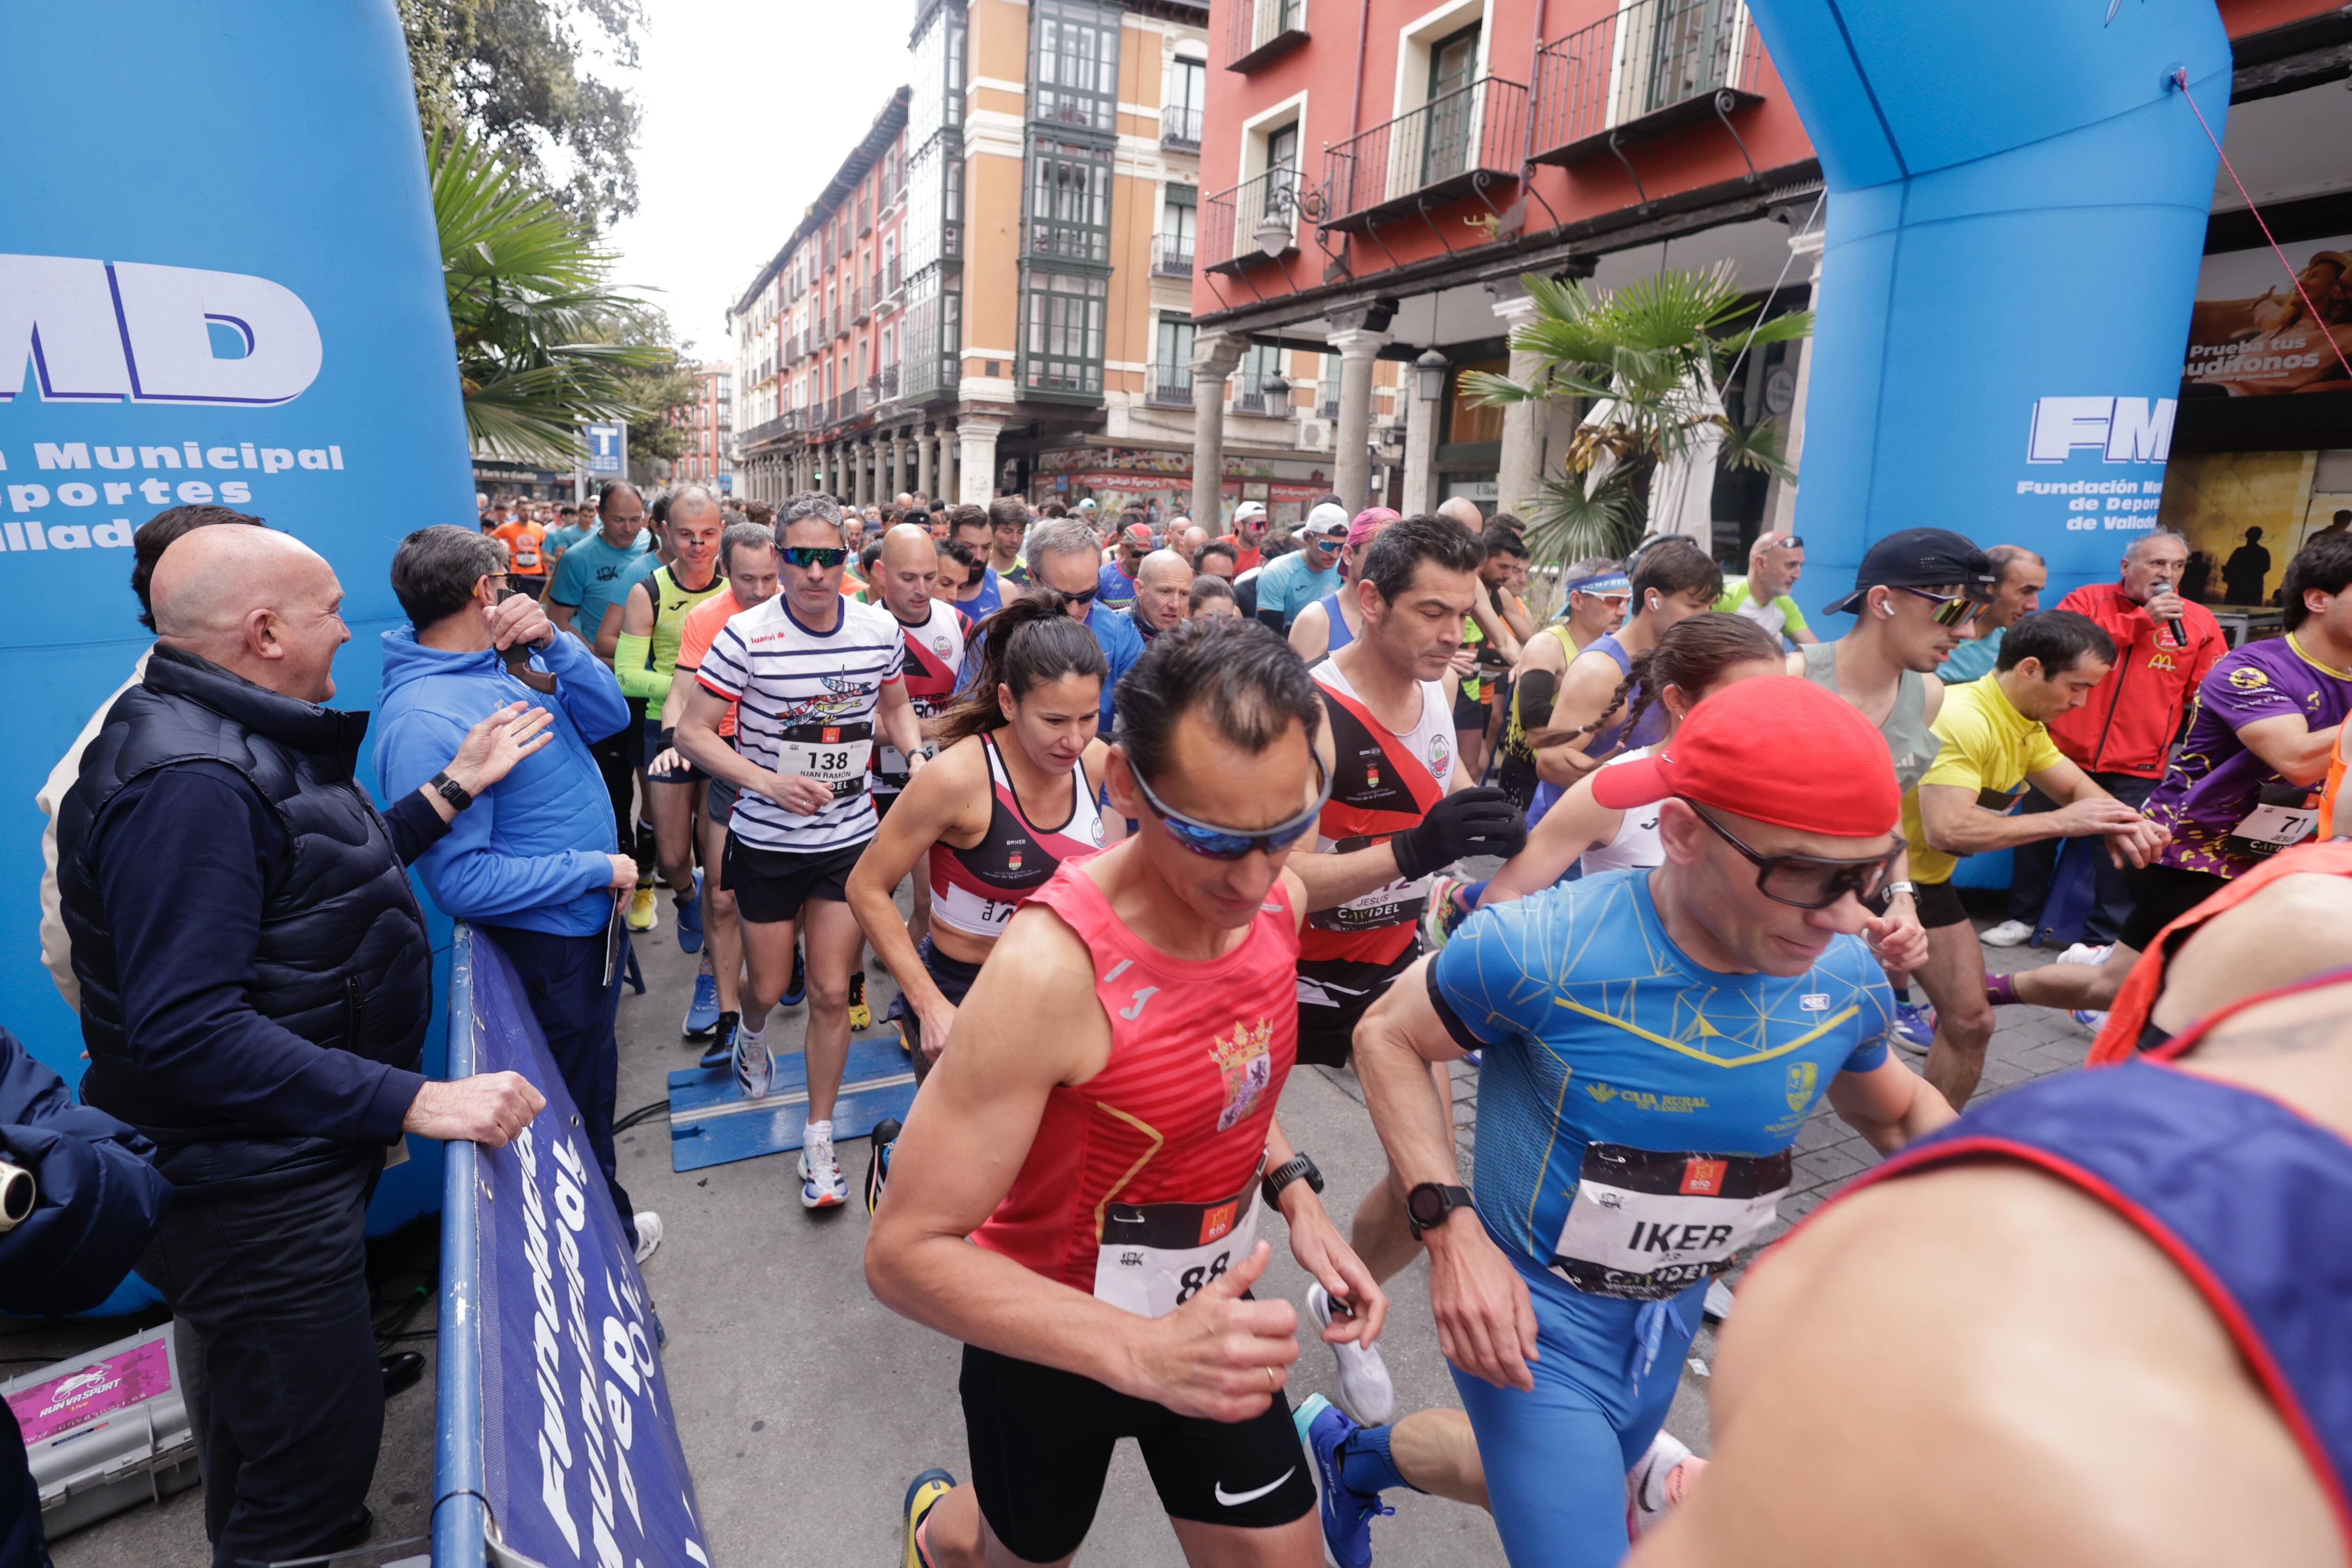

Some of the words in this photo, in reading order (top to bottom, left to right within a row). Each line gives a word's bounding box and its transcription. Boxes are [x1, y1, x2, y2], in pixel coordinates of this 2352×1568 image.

[2189, 340, 2264, 358] Prueba
[2271, 338, 2306, 350] tus
[2181, 353, 2320, 376] udífonos
[34, 441, 344, 474] Municipal
[1132, 477, 1160, 488] Ferrari
[2017, 479, 2138, 494] Fundación
[0, 478, 252, 513] portes
[2068, 497, 2099, 511] de
[2066, 516, 2098, 531] de
[751, 634, 776, 644] luanvi
[808, 752, 848, 770] 138
[823, 770, 850, 779] RAMÓN
[2279, 816, 2309, 834] 71
[1357, 895, 1389, 907] JESUS
[1337, 903, 1400, 919] CAVIDEL
[1628, 1221, 1734, 1252] IKER
[1176, 1250, 1230, 1306] 88
[511, 1119, 581, 1560] Fundació
[71, 1401, 88, 1411] Live
